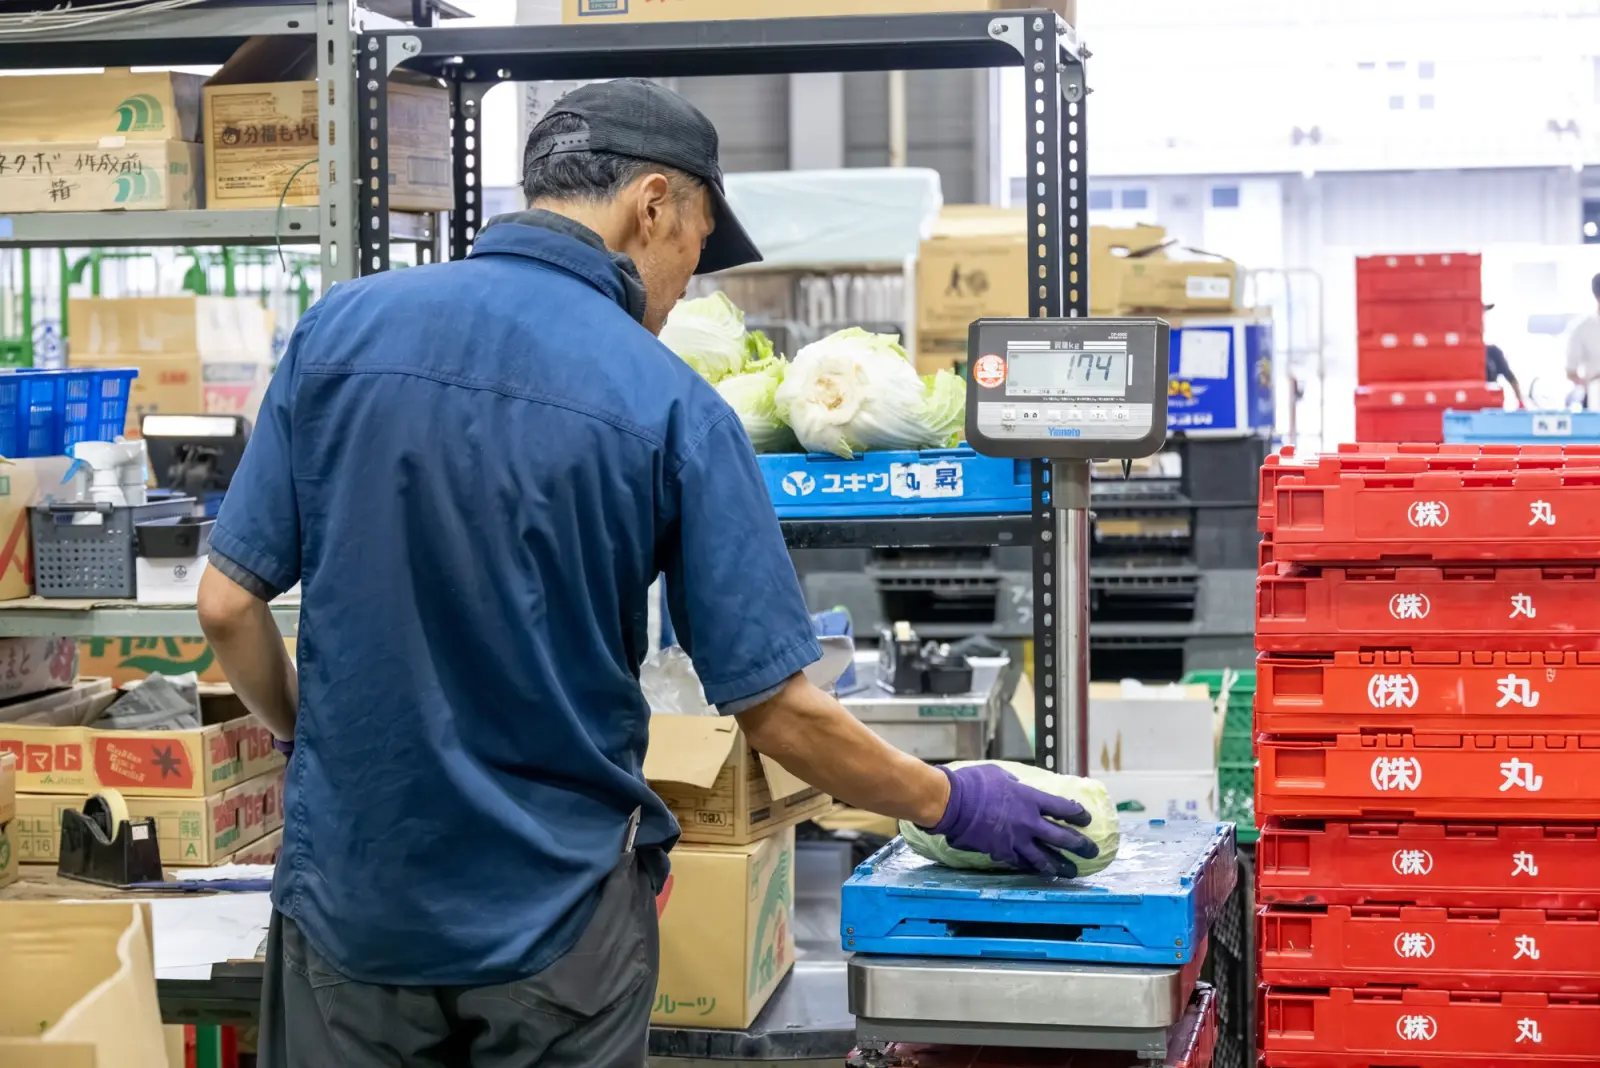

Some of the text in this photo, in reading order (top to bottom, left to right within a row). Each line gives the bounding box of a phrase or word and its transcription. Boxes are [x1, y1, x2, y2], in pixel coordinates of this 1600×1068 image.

[75, 152, 142, 176] 作成前
[48, 178, 80, 203] 箱
[1408, 500, 1556, 528] (株) 丸
[1389, 593, 1536, 619] (株) 丸
[1367, 674, 1419, 708] (株)
[1496, 674, 1540, 708] 丸
[1370, 756, 1543, 792] (株) 丸
[37, 820, 49, 833] L
[36, 839, 50, 852] 16
[185, 842, 198, 857] A
[1392, 849, 1538, 876] (株) 丸
[1394, 933, 1540, 960] (株) 丸
[655, 994, 716, 1016] ルーツ
[1396, 1015, 1542, 1043] (株) 丸
